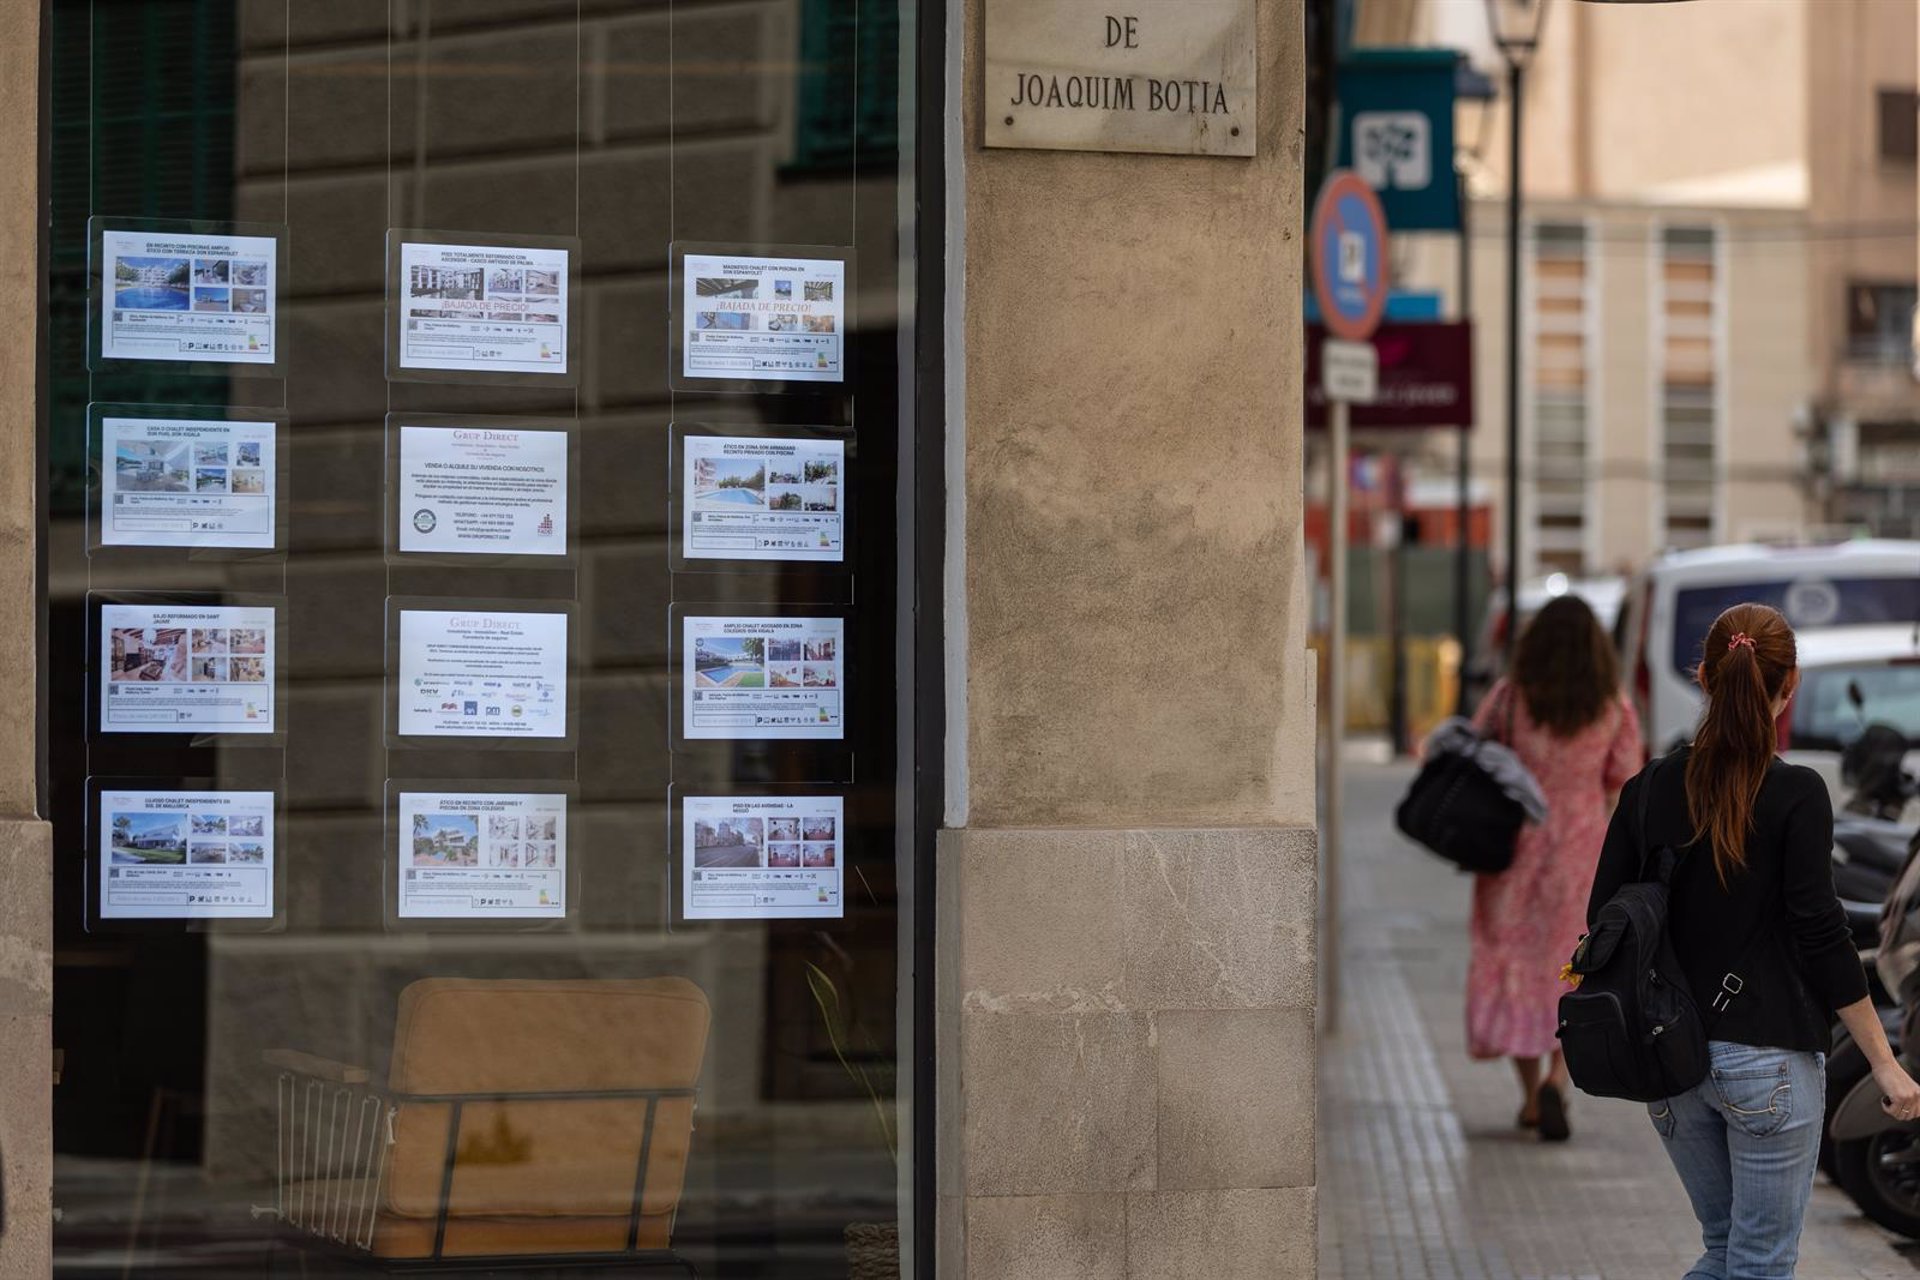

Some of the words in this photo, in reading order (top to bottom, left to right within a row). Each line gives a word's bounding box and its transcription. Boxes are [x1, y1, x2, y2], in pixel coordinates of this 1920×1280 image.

[1105, 15, 1139, 49] DE
[1011, 74, 1136, 111] JOAQUIM
[1148, 79, 1229, 114] BOTIA
[479, 302, 490, 310] DE
[758, 302, 770, 312] DE
